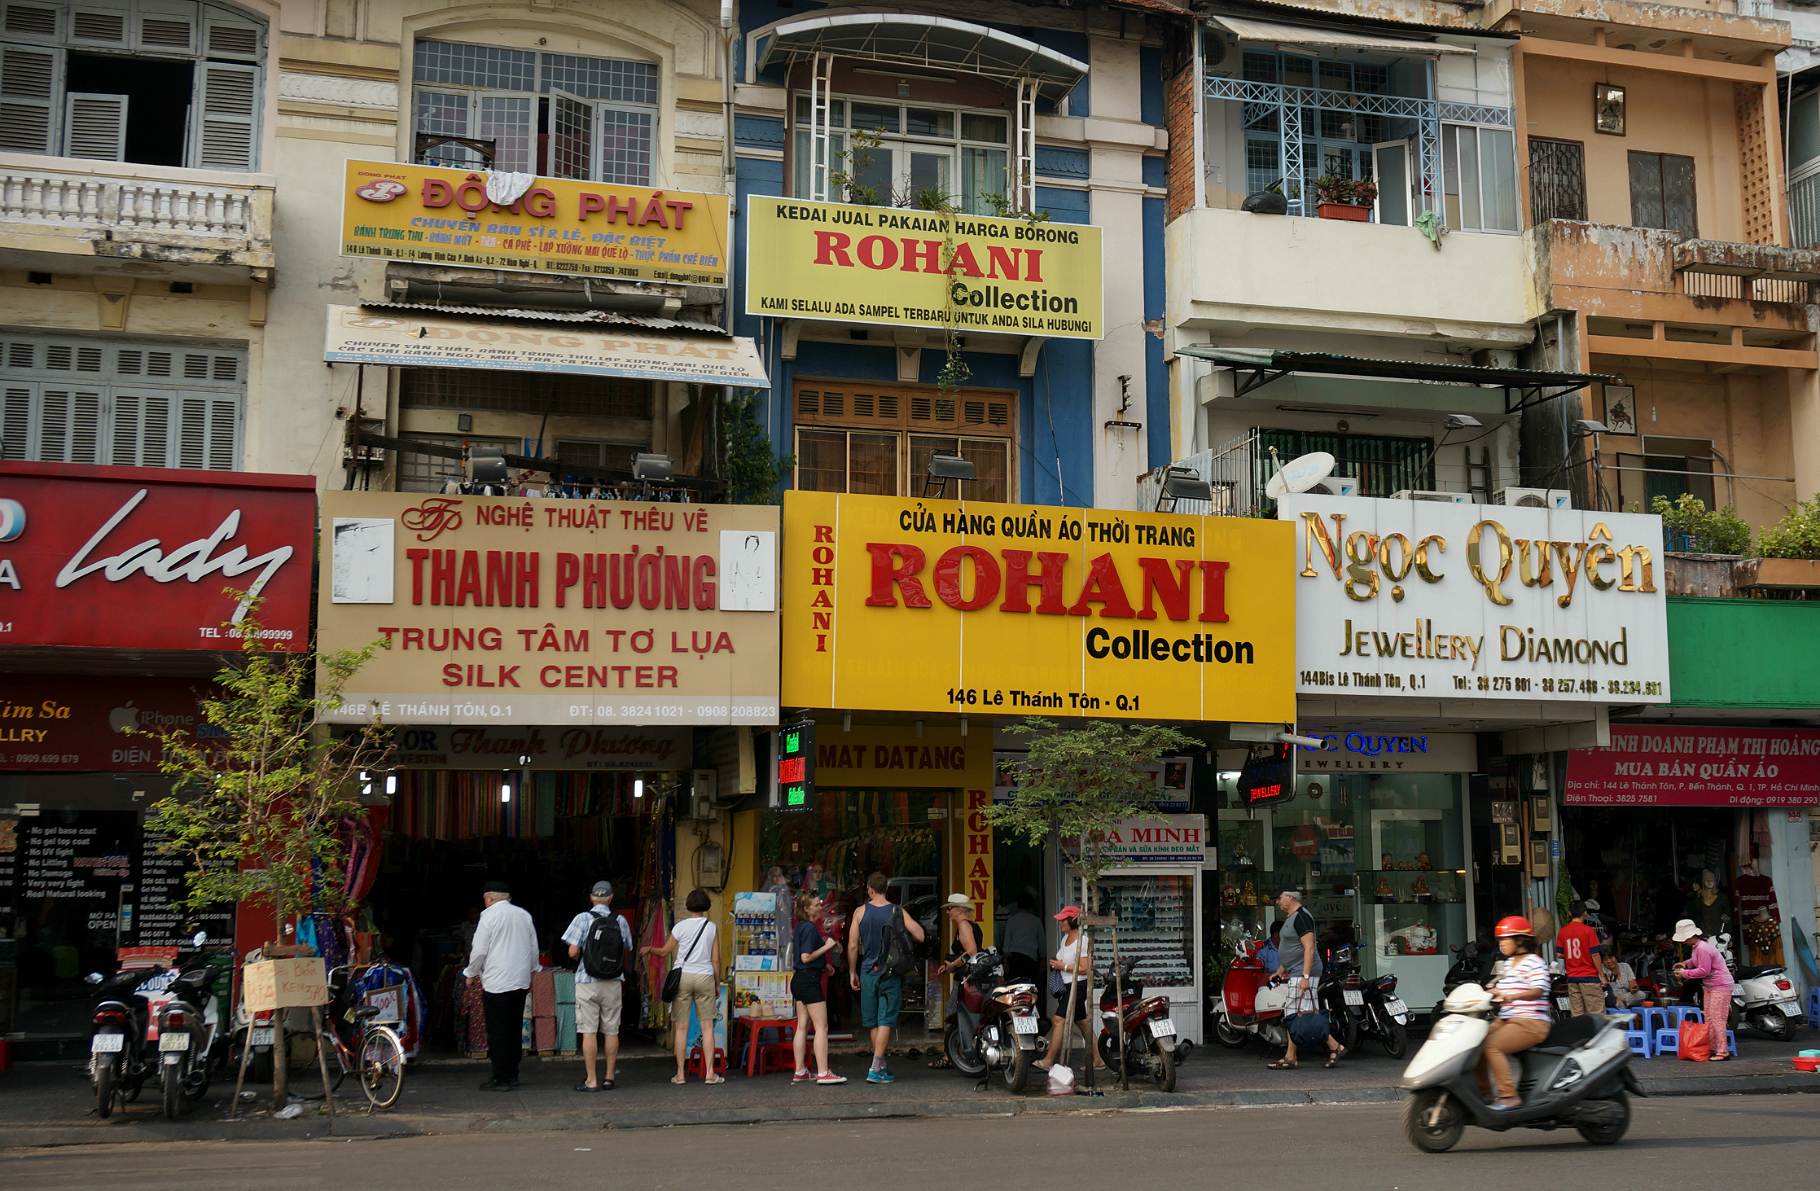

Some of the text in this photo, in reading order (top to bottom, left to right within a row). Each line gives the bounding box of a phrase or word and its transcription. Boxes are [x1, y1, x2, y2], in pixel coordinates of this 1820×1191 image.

[421, 173, 693, 230] ĐỘG PHÁT
[776, 204, 1079, 245] KEDAI JUAL PAKAIAN HARGA BORONG
[813, 230, 1043, 283] ROHANI
[952, 282, 1078, 314] Collection
[761, 296, 1092, 333] KAMI SELALU ADA SAMPEL TERBARU UNTUK ANDA SILA HUBUNGI
[476, 502, 708, 534] NGHỆ THUẬT THÊU VẼ
[899, 502, 1196, 548] CỬA HÀNG QUẦN ÁO THỜI TRANG
[55, 488, 294, 626] Lady
[1300, 511, 1658, 609] Ngọc Quyên
[406, 544, 716, 611] THANH PHƯƠNG
[811, 524, 835, 654] ROHANI
[864, 542, 1231, 623] ROHANI
[199, 627, 221, 638] TEL
[378, 622, 735, 660] TRUNG TÂM TƠ LỤA
[1085, 626, 1255, 664] Collection
[442, 662, 678, 689] SILK CENTER
[1300, 670, 1335, 686] 144Bis
[1338, 672, 1349, 687] Lê
[1352, 672, 1382, 688] Thánh
[1492, 676, 1511, 692] 275
[39, 700, 72, 720] Sa
[398, 700, 450, 716] THÁNH
[568, 705, 593, 717] ĐT:
[696, 705, 728, 718] 0908
[730, 706, 776, 718] 208823
[946, 688, 1140, 713] 146 Lê Thánh Tôn Q.1
[141, 710, 195, 727] iPhone
[111, 746, 152, 766] ĐIỆN
[873, 746, 965, 771] DATANG
[1641, 735, 1695, 754] DOANH
[1697, 736, 1740, 758] PHẠM
[1742, 738, 1768, 760] THỊ
[1304, 760, 1404, 769] EWELLERY
[1614, 757, 1778, 780] MUA BÁN QUẦN ÁO
[1568, 780, 1582, 790] Địa
[1620, 782, 1630, 790] Lê
[1632, 782, 1658, 790] Thánh
[1800, 784, 1820, 792] Minh
[1566, 794, 1586, 802] Điện
[1766, 796, 1786, 804] 0919
[1131, 828, 1201, 843] MINH
[88, 920, 117, 930] OPEN
[1565, 938, 1582, 960] 18
